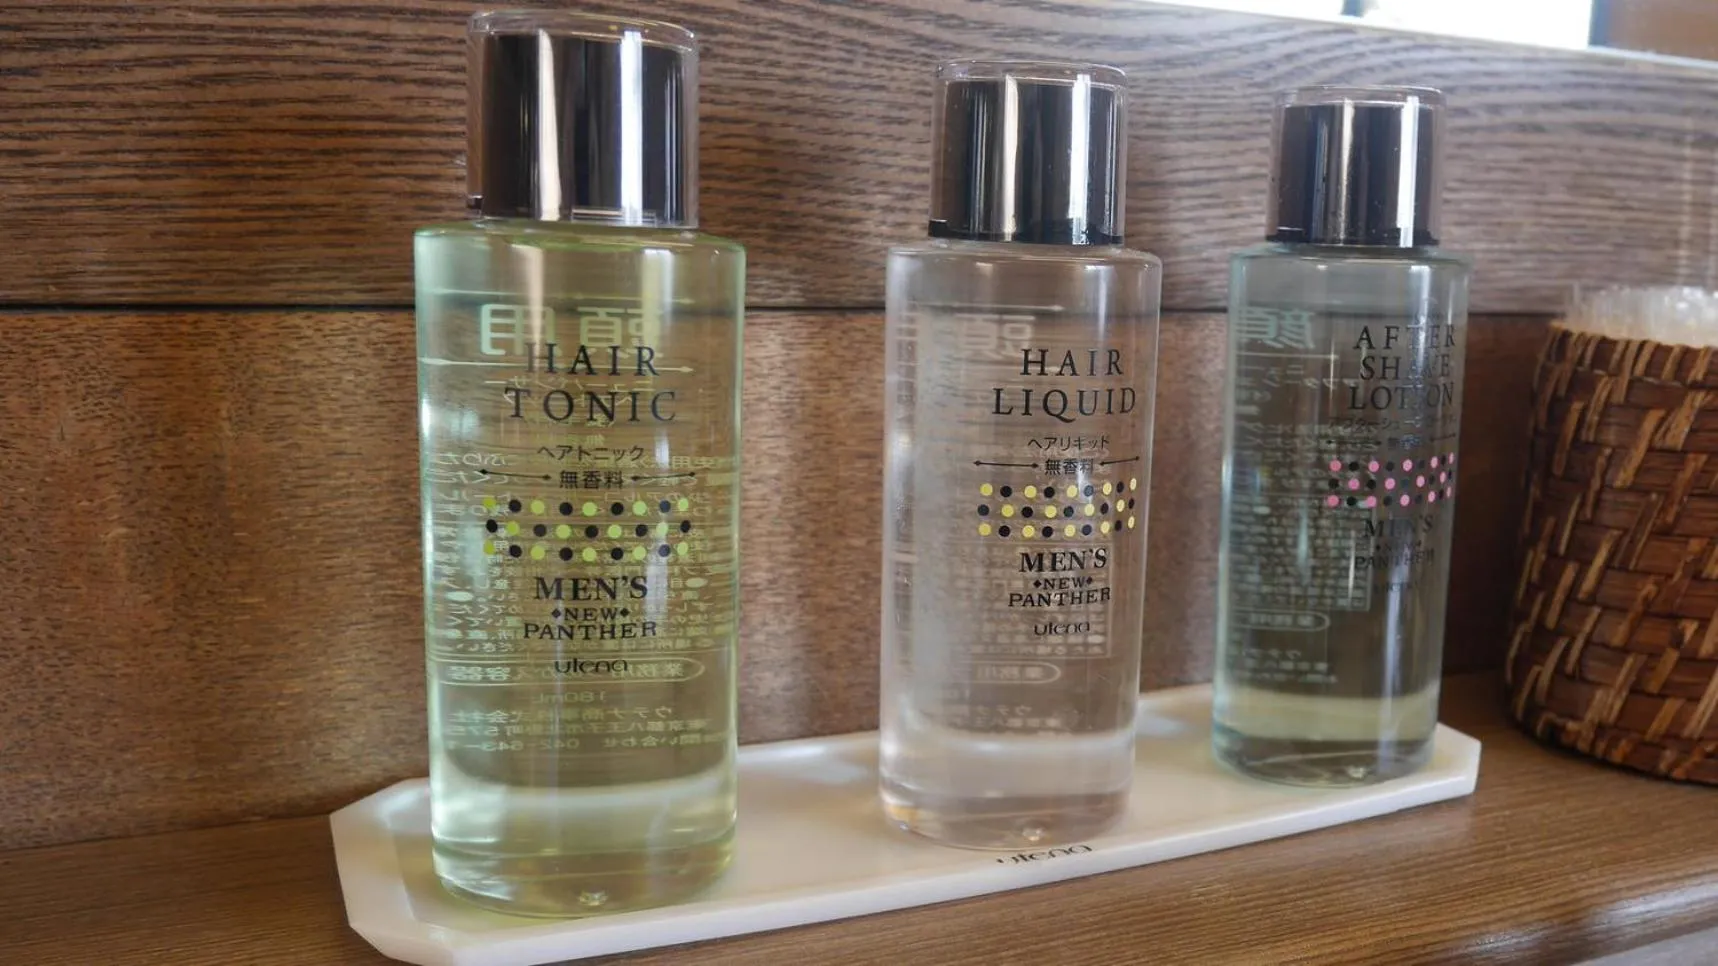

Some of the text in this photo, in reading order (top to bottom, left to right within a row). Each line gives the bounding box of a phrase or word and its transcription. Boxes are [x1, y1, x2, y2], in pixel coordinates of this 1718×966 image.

[1352, 323, 1456, 350] AFTER
[524, 342, 660, 376] HAIR
[1019, 348, 1125, 376] HAIR
[1359, 353, 1451, 381] SHVE
[504, 386, 677, 423] TONIC
[991, 387, 1137, 424] LIQUID
[1347, 381, 1455, 411] LOTON
[537, 444, 645, 462] ヘアトニック
[1027, 435, 1110, 451] ヘアリキッド
[1044, 458, 1095, 476] 無香料
[558, 469, 625, 490] 無香料
[1018, 547, 1109, 573] MEN'S
[534, 575, 649, 602] MEN'S
[1042, 576, 1087, 590] NEW
[1007, 586, 1112, 608] PANTHER
[563, 607, 619, 621] NEW
[523, 620, 658, 641] PANTHER
[1033, 621, 1091, 636] utena
[554, 657, 629, 674] utena
